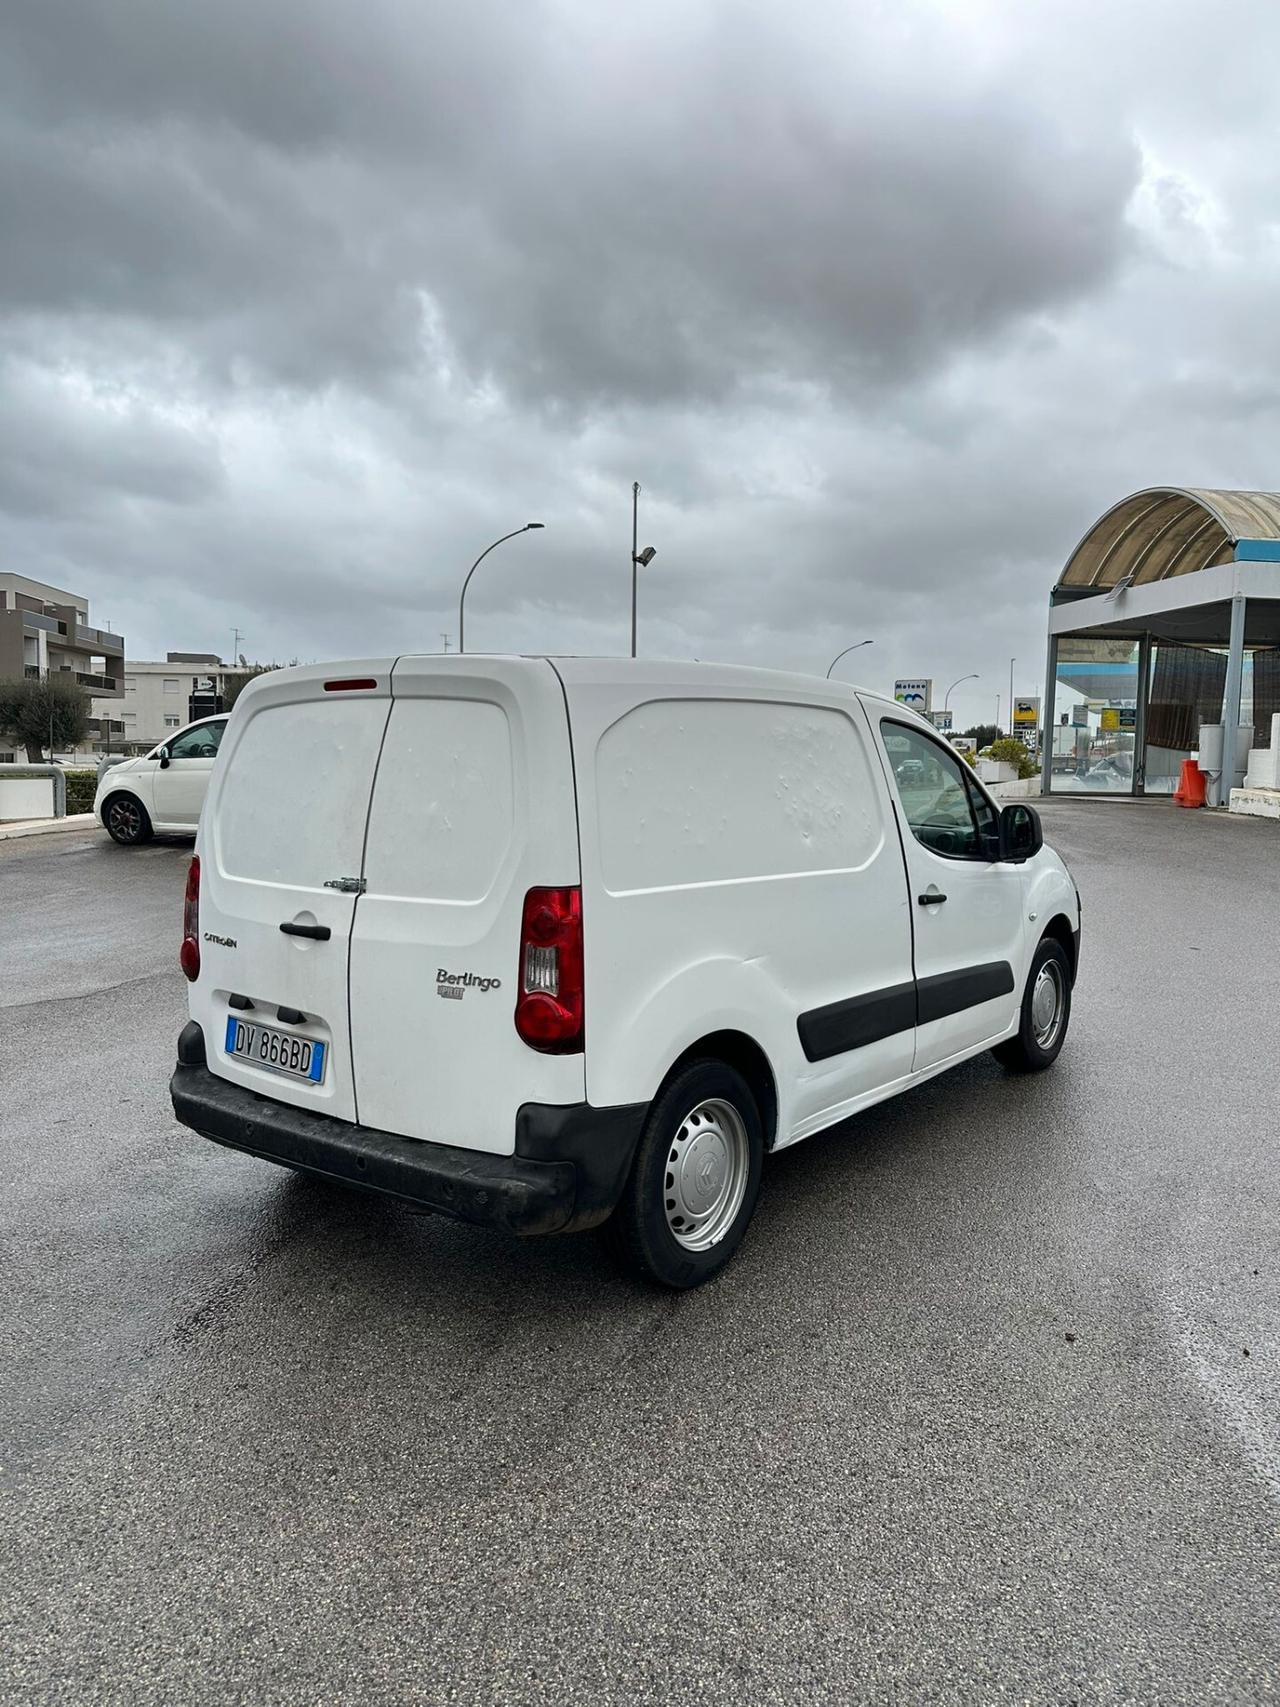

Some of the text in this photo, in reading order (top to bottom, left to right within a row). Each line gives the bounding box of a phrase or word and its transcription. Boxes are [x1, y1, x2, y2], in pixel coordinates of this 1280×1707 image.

[436, 968, 501, 992] Berlingo
[236, 1023, 312, 1073] DV 866BD
